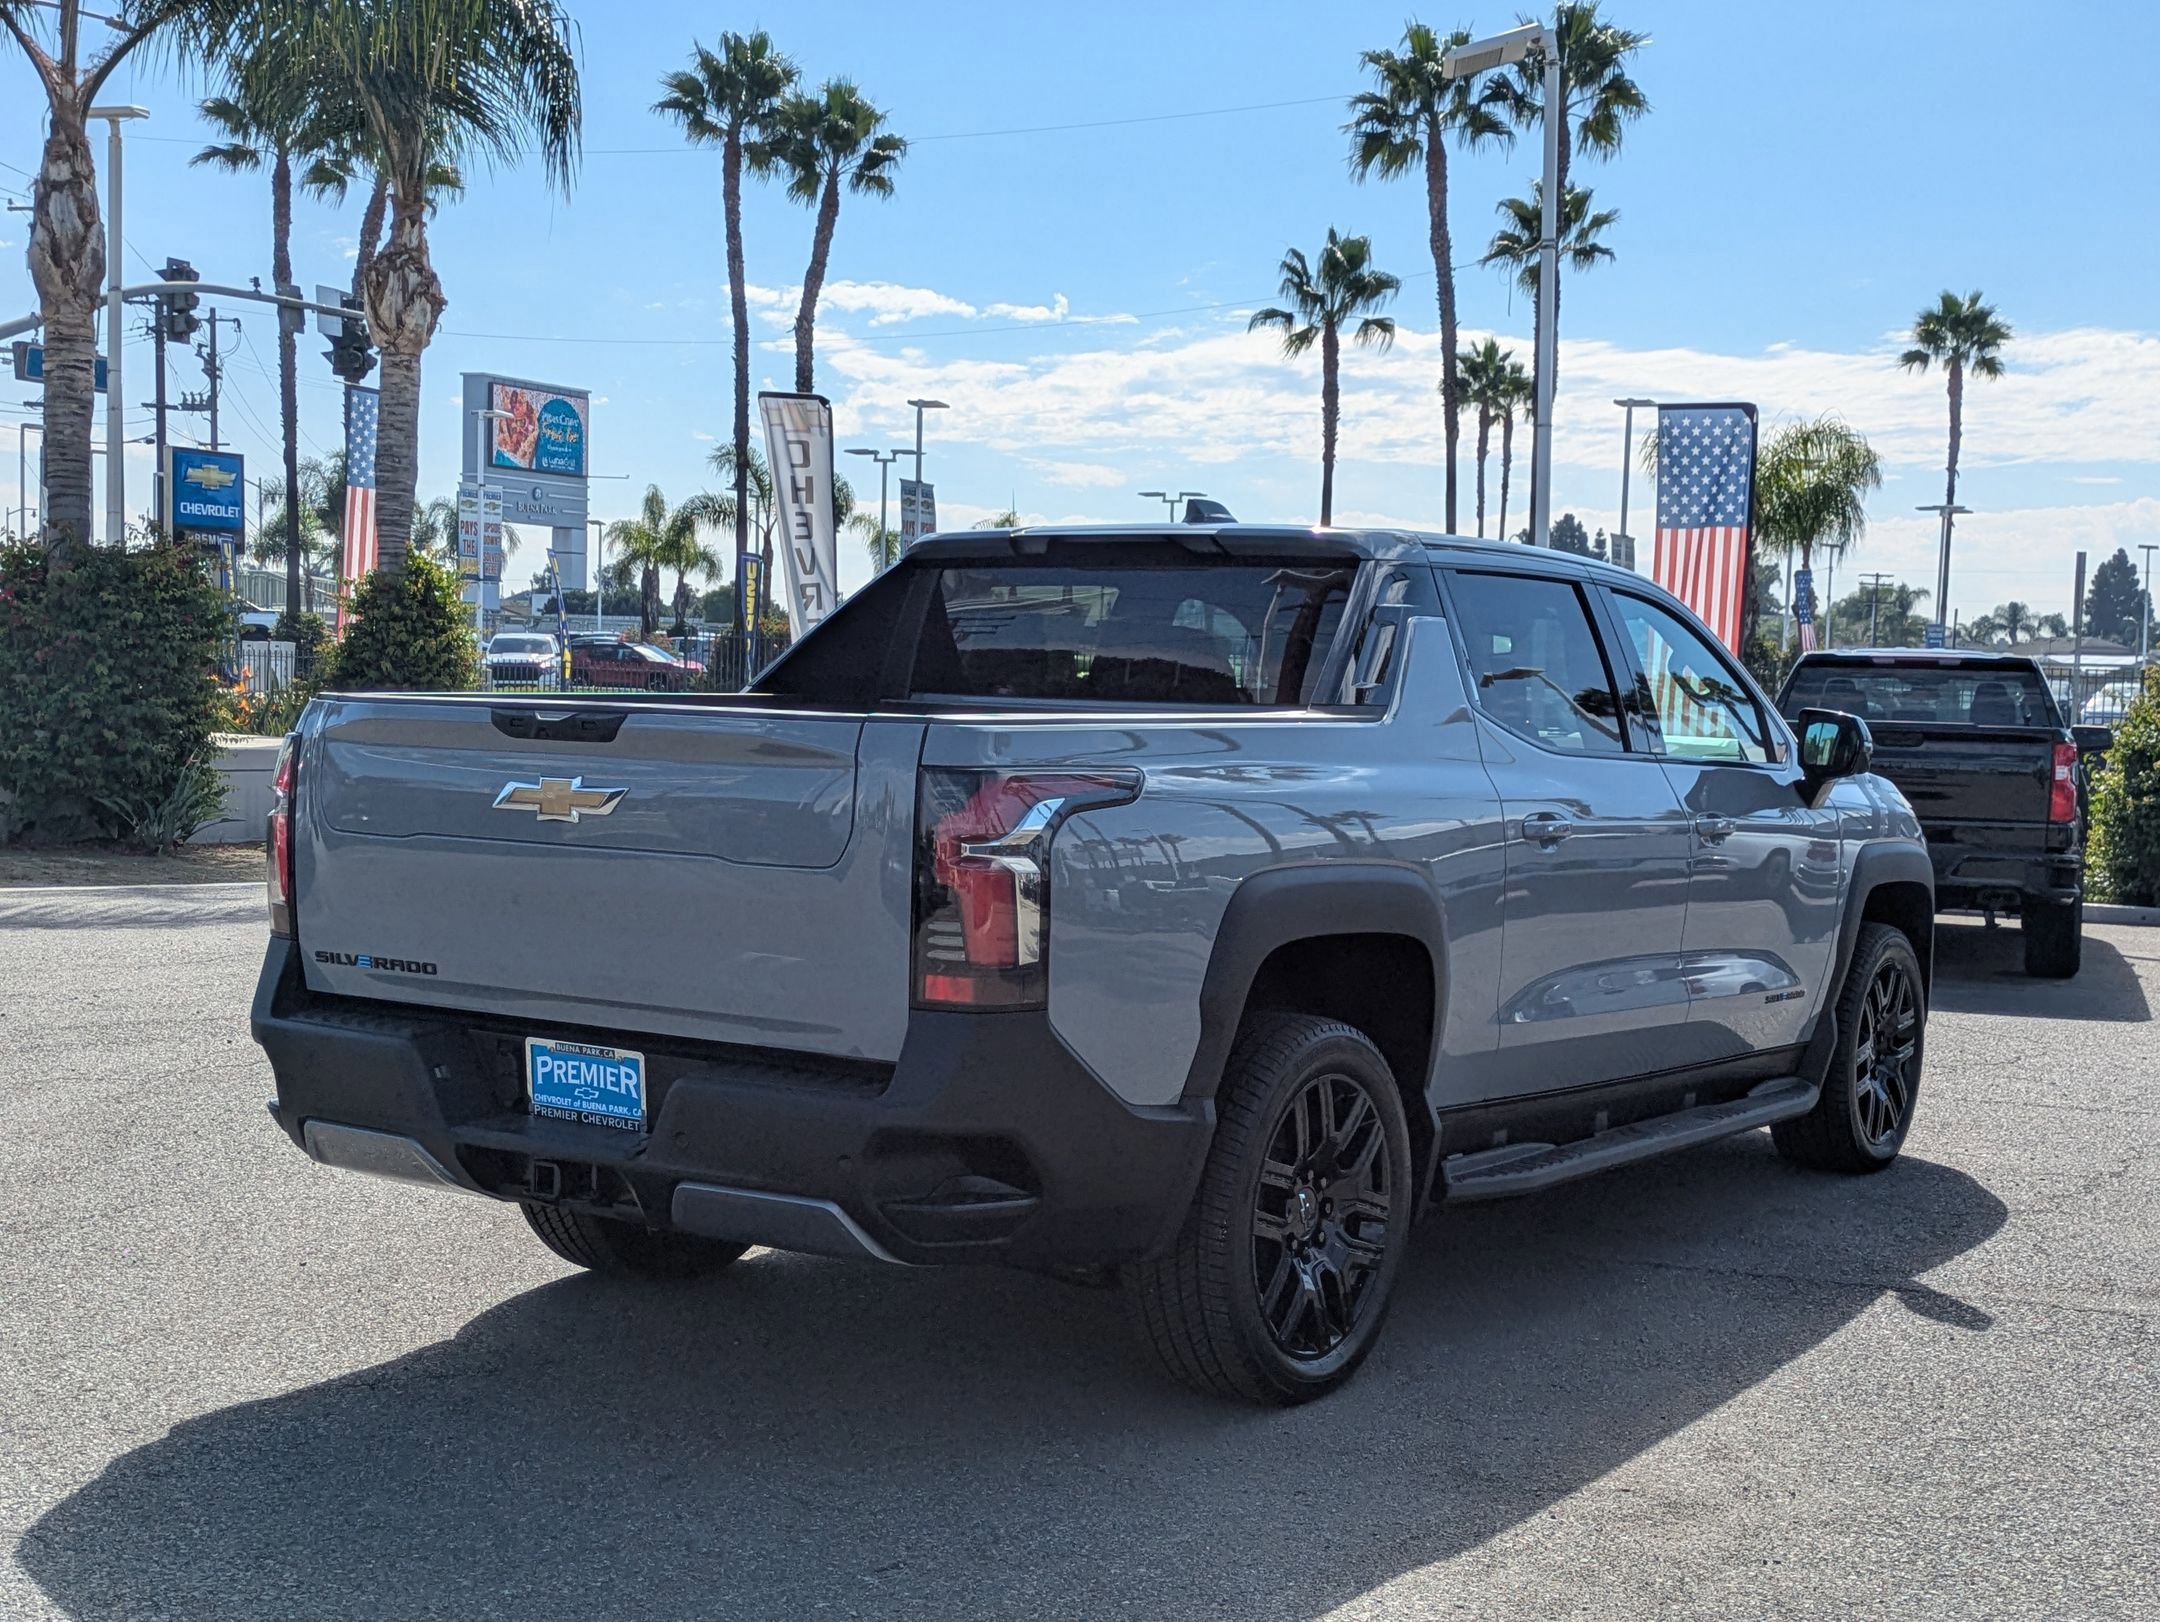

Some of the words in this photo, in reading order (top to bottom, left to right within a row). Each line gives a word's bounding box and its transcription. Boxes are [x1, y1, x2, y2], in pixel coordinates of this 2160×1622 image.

[180, 502, 240, 518] CHEVROLET
[460, 520, 478, 536] PAYS
[463, 540, 475, 555] THE
[315, 951, 437, 975] SILVERADO
[556, 1043, 580, 1053] BUENA
[604, 1049, 614, 1058] CA
[536, 1055, 639, 1100] PREMIER
[534, 1093, 571, 1106] CHEVROLET
[573, 1099, 581, 1108] of
[583, 1101, 607, 1112] BUENA
[633, 1108, 642, 1116] CA
[534, 1104, 578, 1121] PREMIER
[581, 1112, 640, 1131] CHEVROLET
